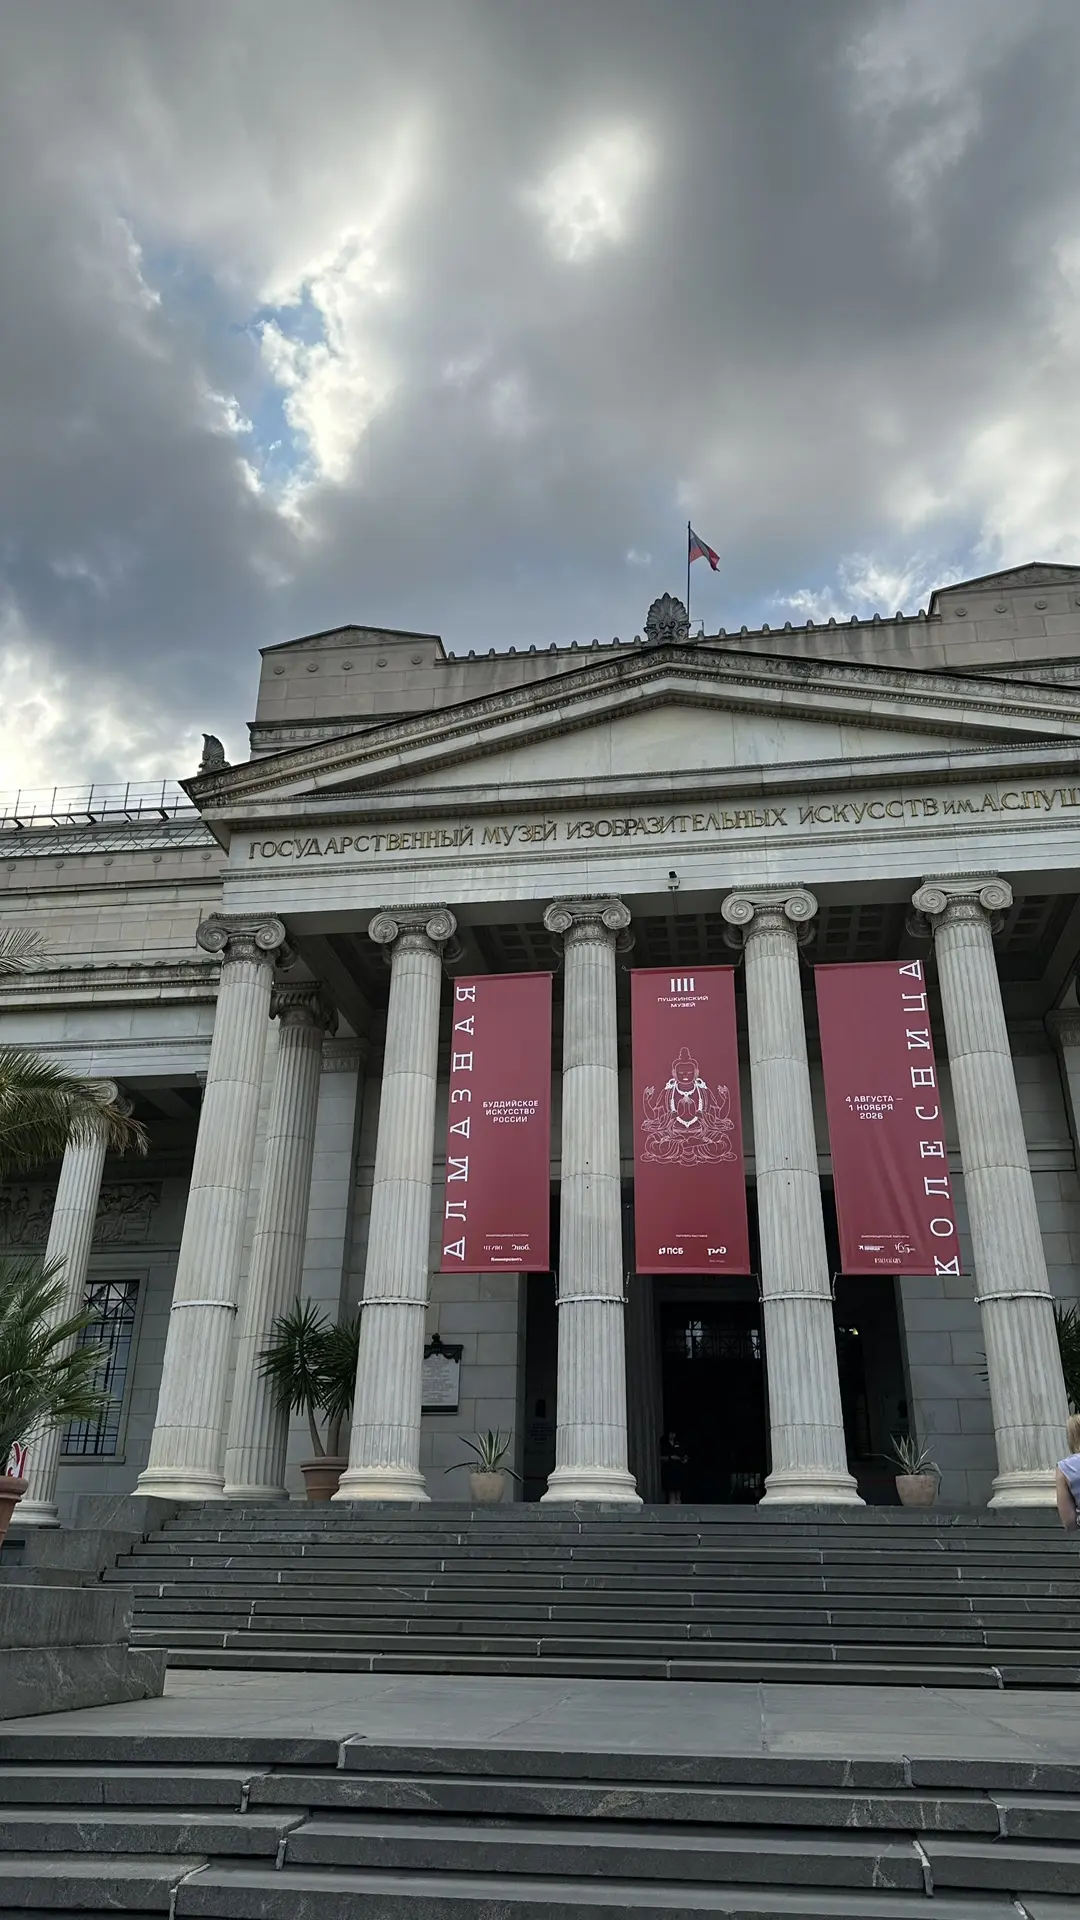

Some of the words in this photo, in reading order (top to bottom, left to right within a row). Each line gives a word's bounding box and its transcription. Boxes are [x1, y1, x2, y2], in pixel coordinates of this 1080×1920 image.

[248, 824, 474, 860] ГОСУДАРСТВЕННЫЙ
[481, 820, 558, 847] МУЗЕЙ
[566, 807, 788, 840] ИЗОБРАЗИТЕЛЬНЫХ
[798, 797, 940, 825] ИСКУССТВ
[845, 1095, 851, 1103] 4
[854, 1095, 894, 1103] АВГУСТА
[482, 1100, 539, 1108] БУДДИЙСКОЕ
[856, 1103, 894, 1111] НОЯБРЯ
[485, 1108, 536, 1116] ИСКУССТВО
[859, 1112, 884, 1120] 2026
[898, 959, 961, 1277] КОЛЕСНИЦА
[443, 984, 477, 1261] АЛМАЗНАЯ
[666, 1247, 684, 1255] ПСБ
